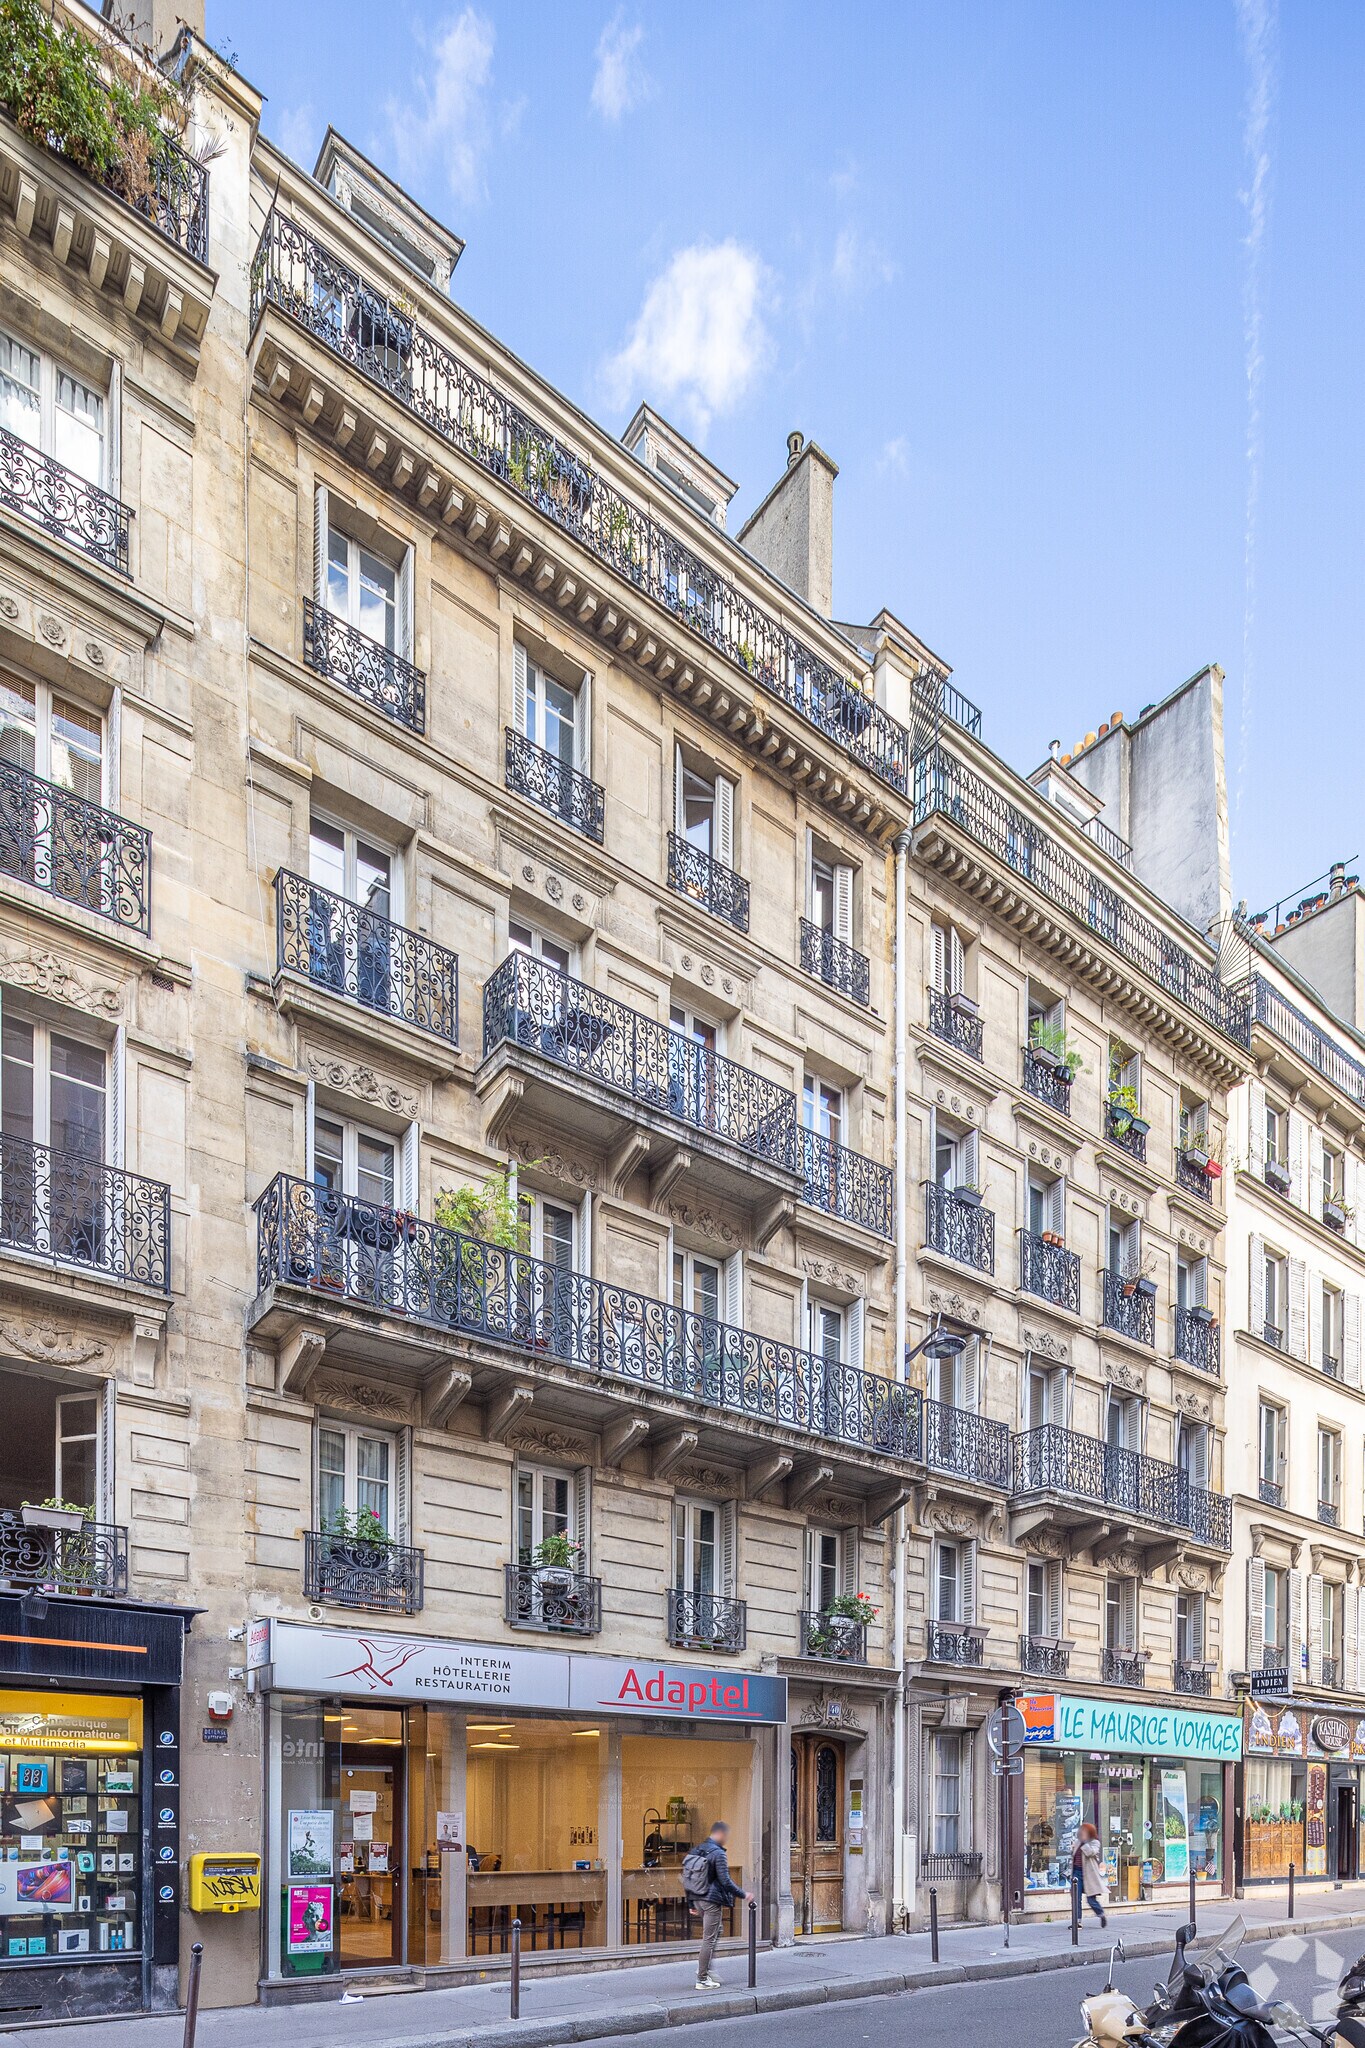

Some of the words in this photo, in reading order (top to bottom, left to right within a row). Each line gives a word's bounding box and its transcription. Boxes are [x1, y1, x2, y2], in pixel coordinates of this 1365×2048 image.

[460, 1657, 511, 1669] INTERIM
[433, 1666, 511, 1681] HÔTELLERIE
[1252, 1669, 1288, 1679] RESTAURANT
[415, 1678, 511, 1693] RESTAURATION
[1256, 1678, 1283, 1687] INDIEN
[618, 1669, 749, 1712] Adaptel
[46, 1727, 121, 1740] Informatique
[1091, 1709, 1168, 1746] MAURICE
[1174, 1717, 1240, 1754] VOYAGES
[1319, 1720, 1349, 1740] KASHMIR
[4, 1737, 16, 1746] et
[20, 1737, 86, 1749] Multimedia
[1255, 1731, 1296, 1749] INDIEN
[1324, 1735, 1343, 1746] HOUSE
